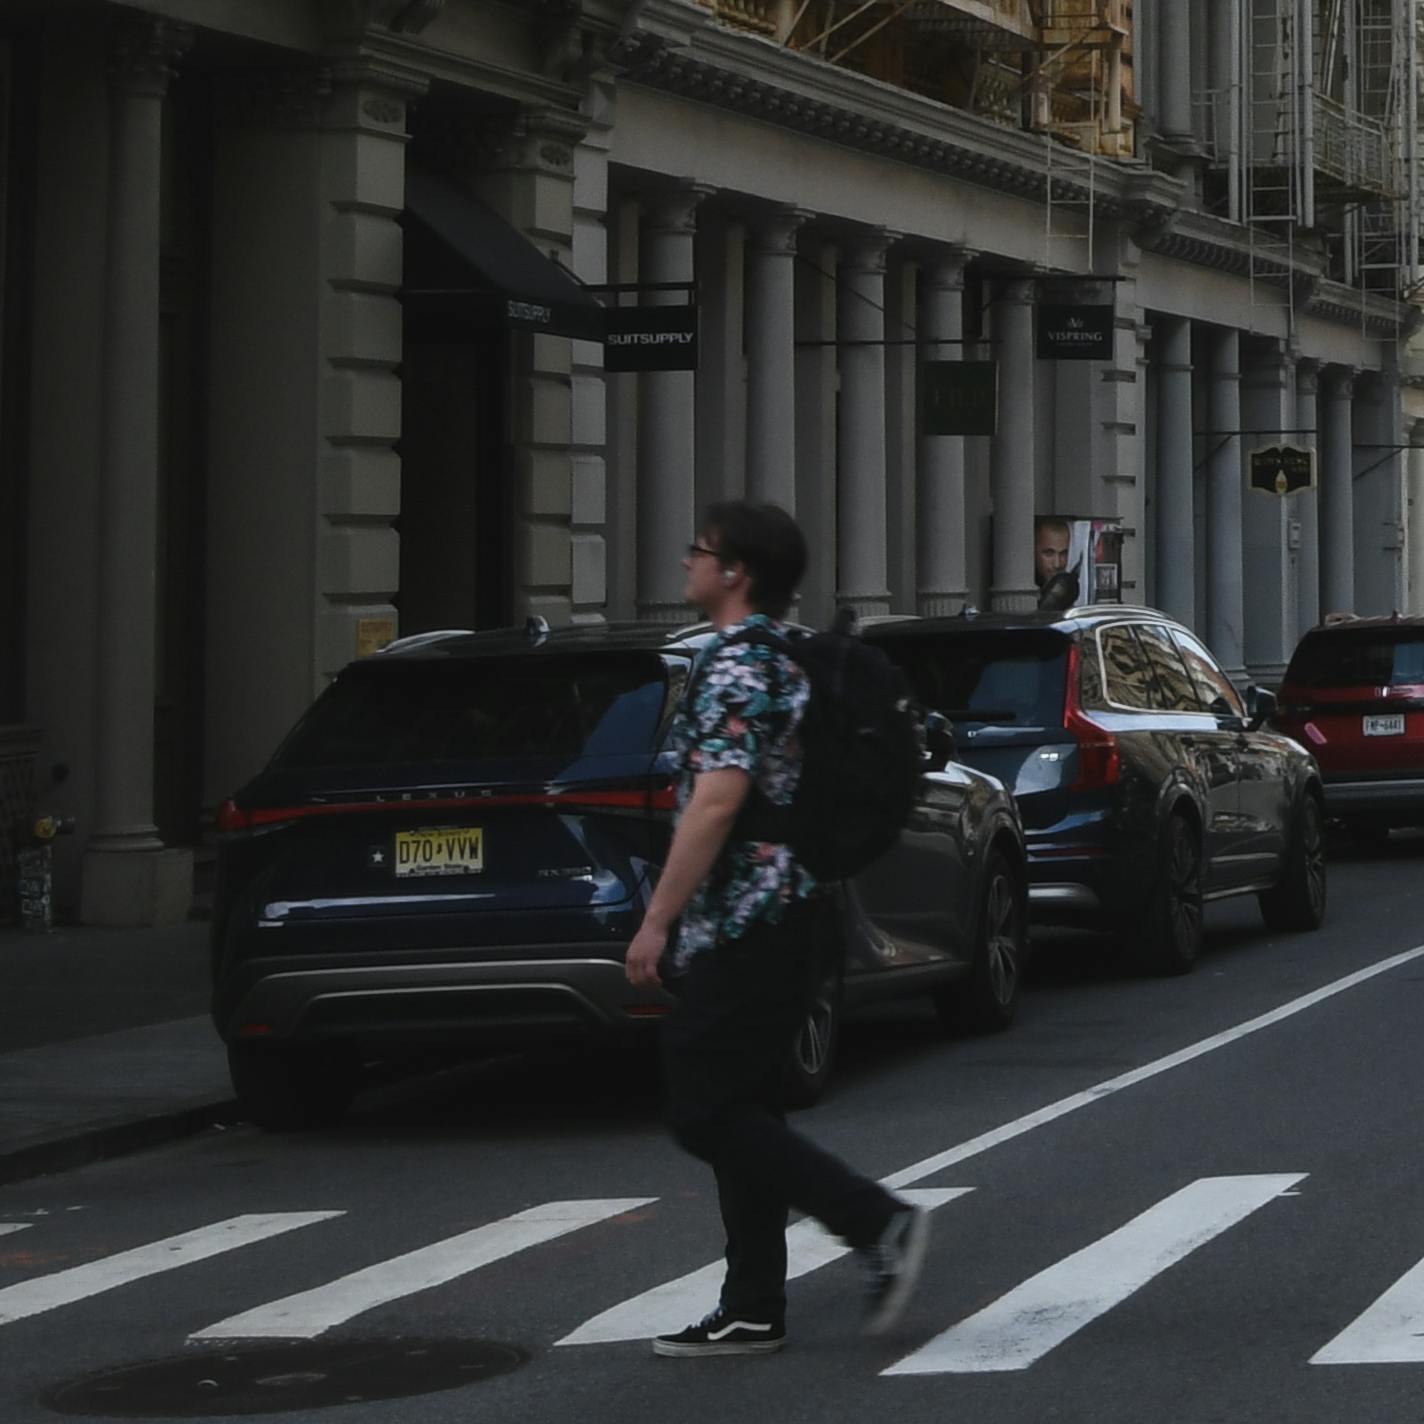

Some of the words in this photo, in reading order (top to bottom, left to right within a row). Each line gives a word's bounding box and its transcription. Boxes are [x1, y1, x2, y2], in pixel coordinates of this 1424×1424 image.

[607, 332, 694, 345] SUITSUPPLY
[1047, 331, 1103, 342] VISPRING
[376, 789, 493, 803] LEXUS
[400, 839, 433, 865] D70
